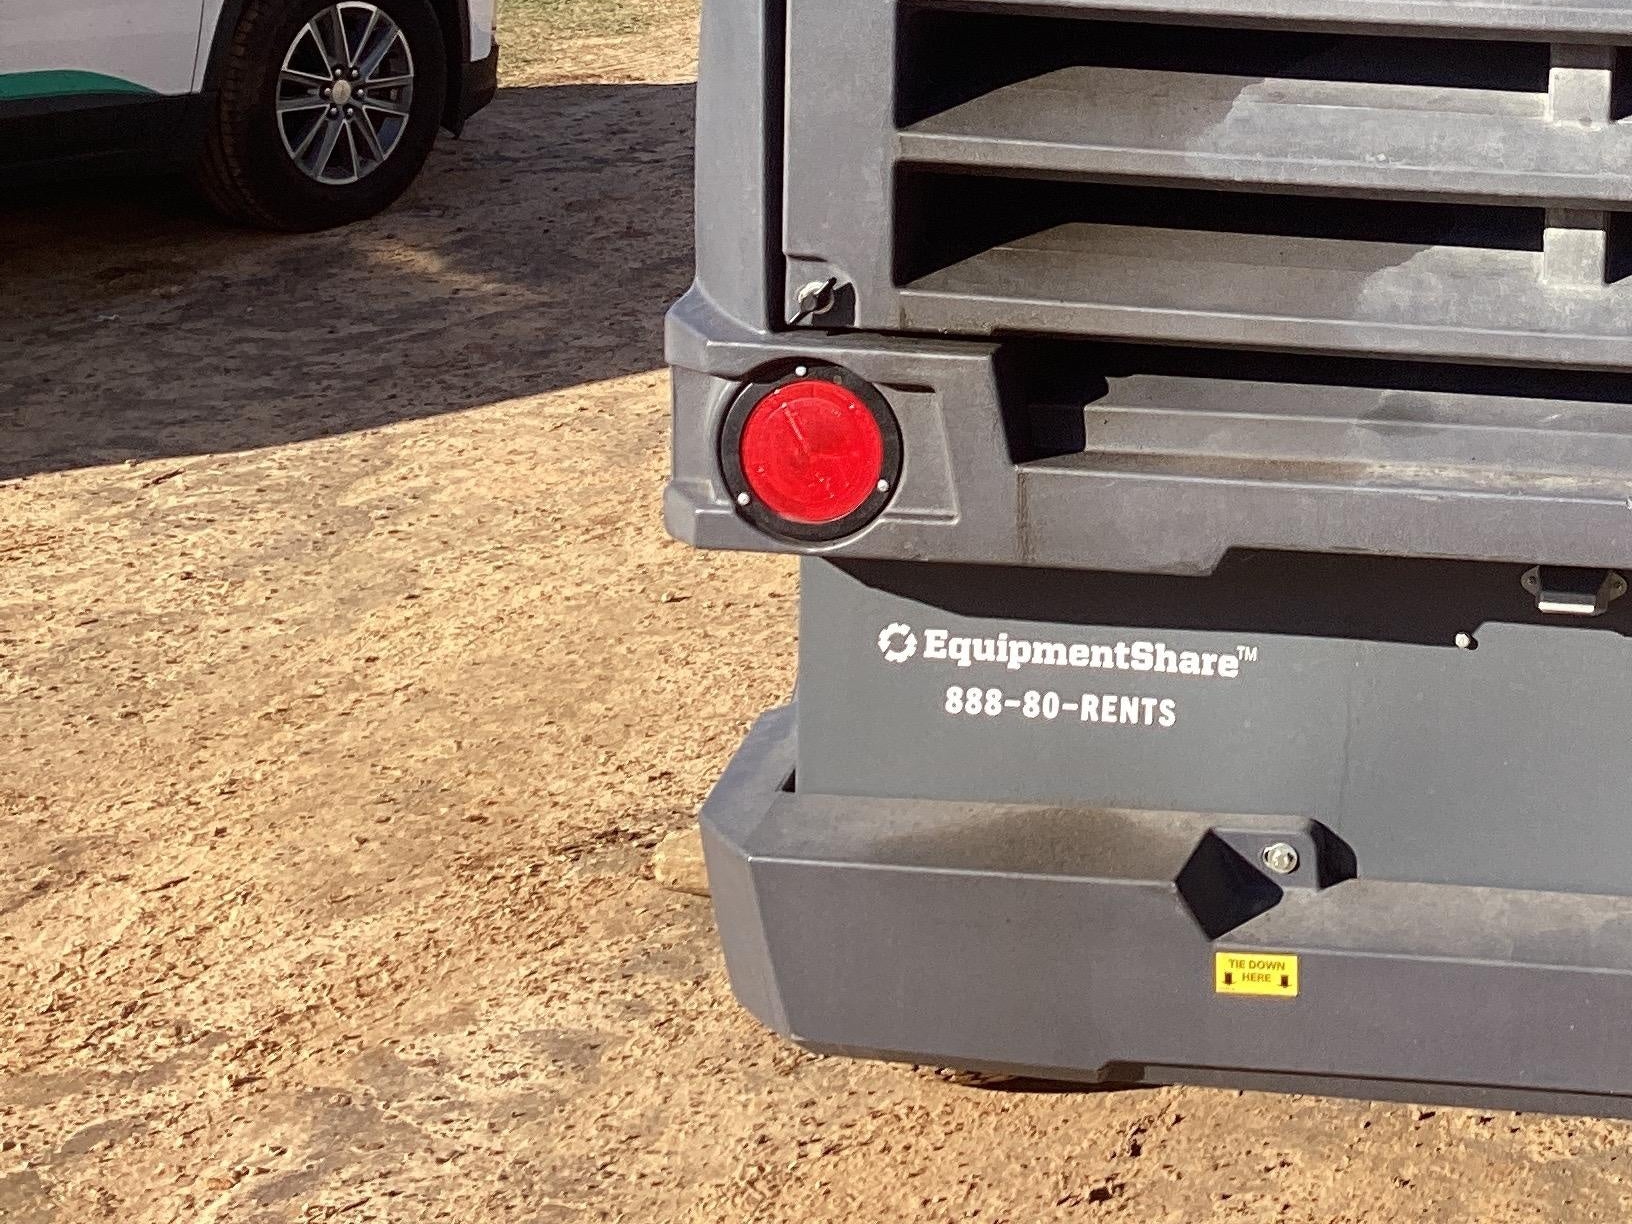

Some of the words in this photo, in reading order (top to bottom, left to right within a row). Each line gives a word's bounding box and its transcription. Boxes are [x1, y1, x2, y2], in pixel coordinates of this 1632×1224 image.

[944, 686, 1177, 727] 888-80-RENTS
[1229, 958, 1246, 969] TIE
[1248, 960, 1286, 971] DOWN
[1241, 972, 1272, 982] HERE
